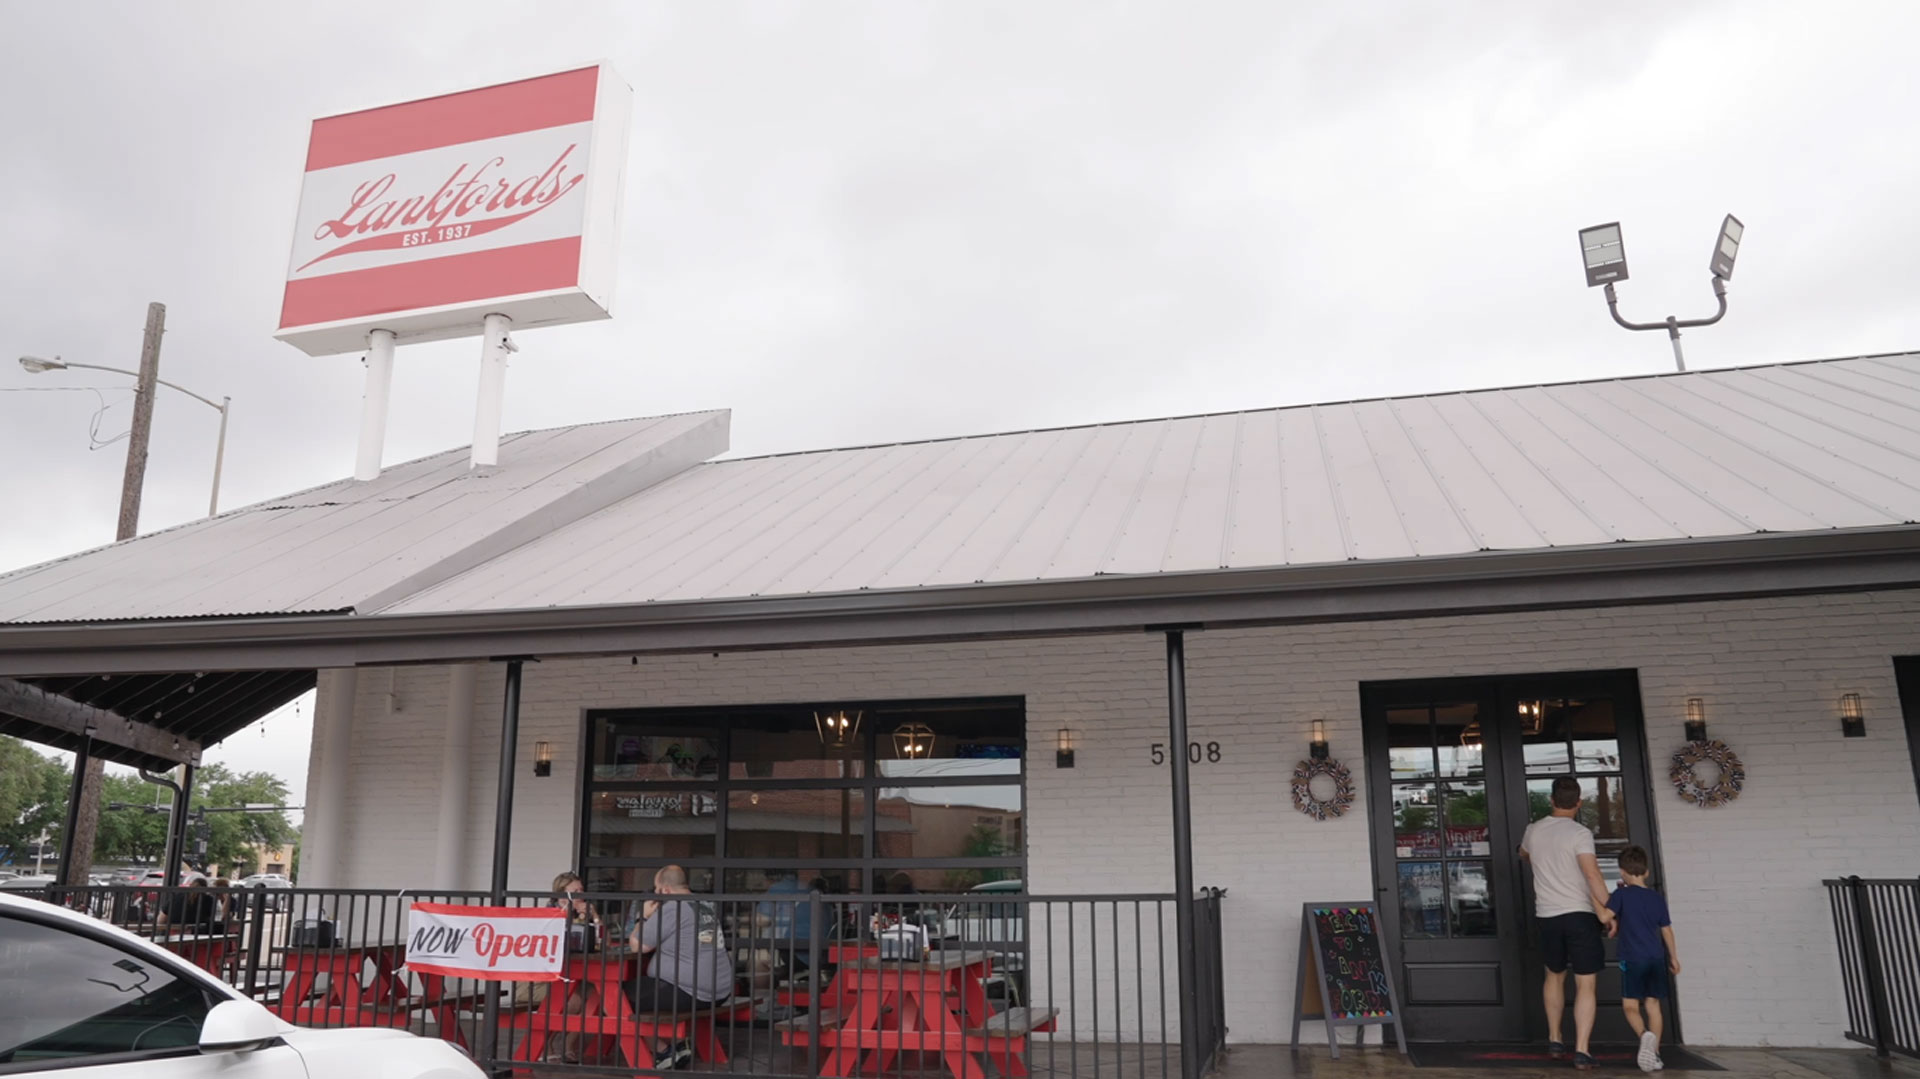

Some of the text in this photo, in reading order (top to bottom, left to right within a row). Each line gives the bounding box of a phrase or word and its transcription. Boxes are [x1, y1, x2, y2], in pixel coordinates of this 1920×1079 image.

[314, 143, 584, 240] Lankfords
[402, 224, 472, 247] EST. 1937
[1151, 741, 1221, 765] 508
[409, 922, 559, 967] NOW Open!
